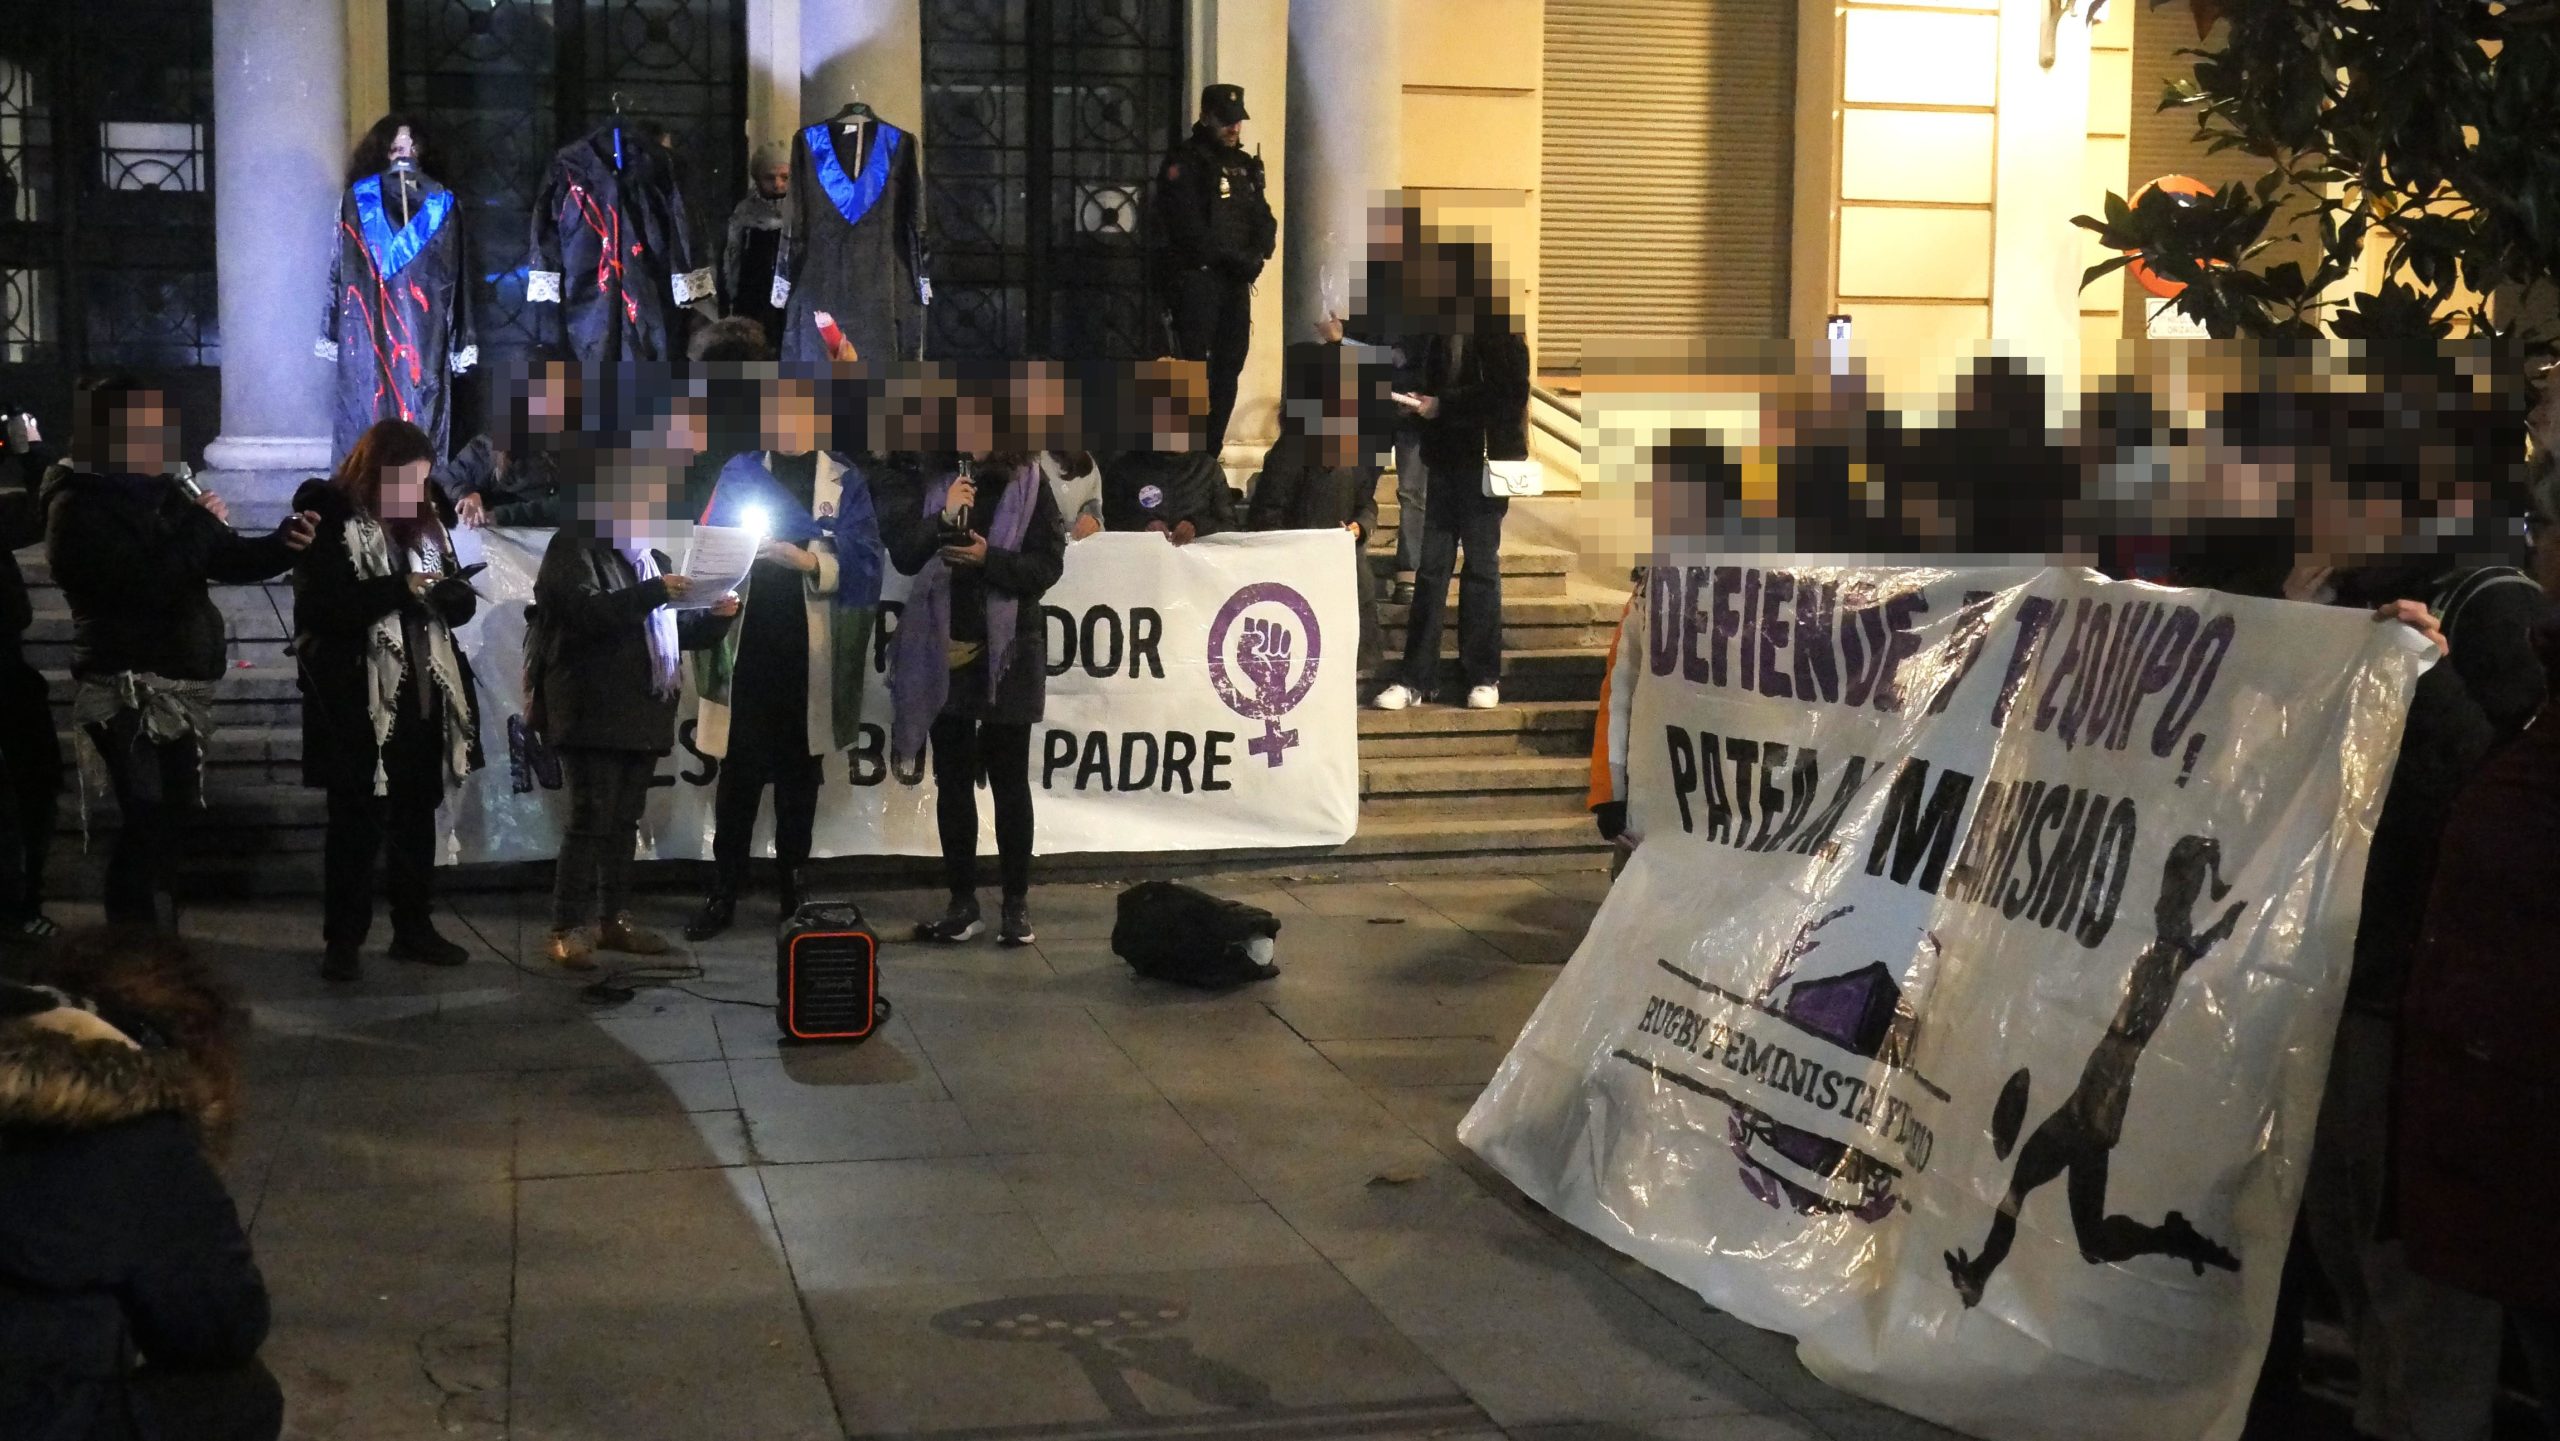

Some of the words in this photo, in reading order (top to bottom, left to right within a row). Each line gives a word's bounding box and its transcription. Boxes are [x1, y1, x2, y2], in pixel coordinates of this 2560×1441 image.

[1043, 729, 1236, 794] PADRE
[1637, 995, 1710, 1053] RUGBY
[1702, 1022, 1877, 1127] FEMINISTA
